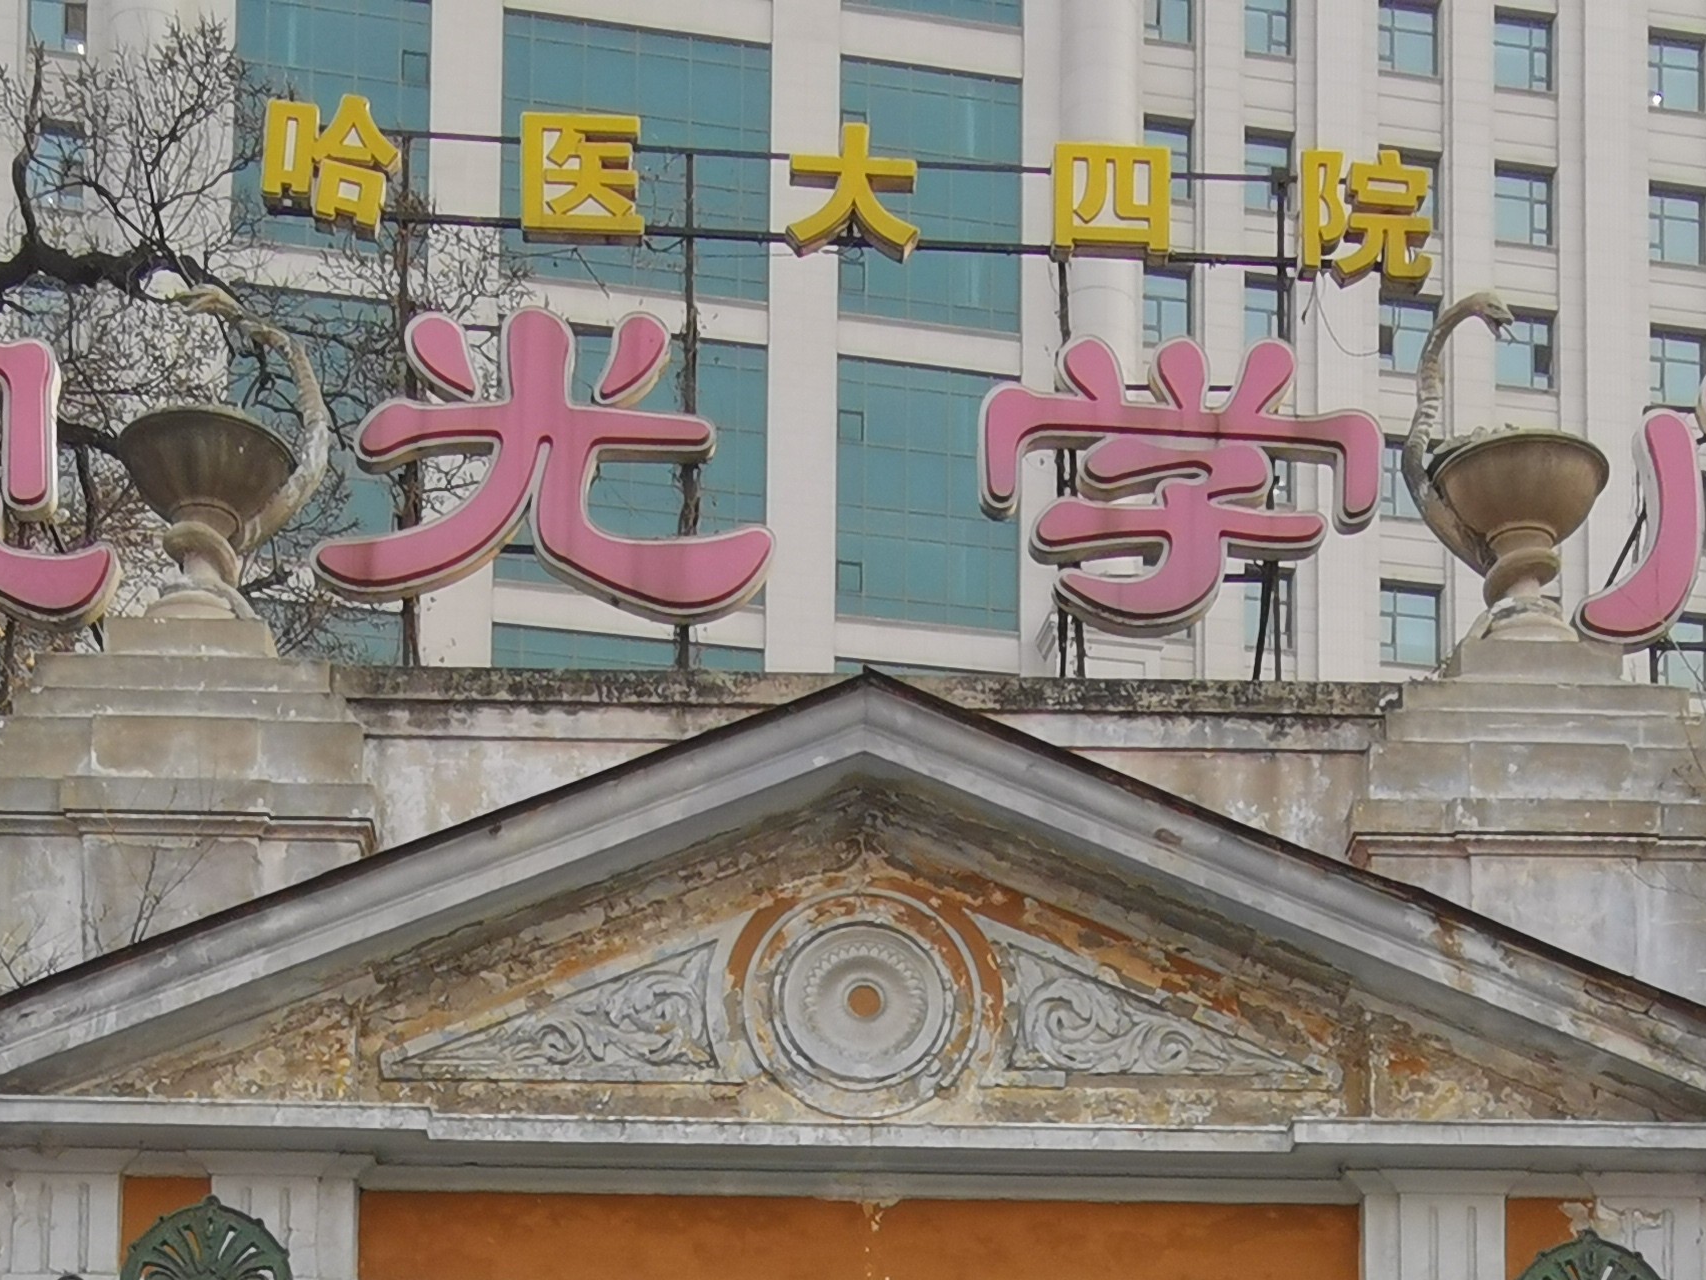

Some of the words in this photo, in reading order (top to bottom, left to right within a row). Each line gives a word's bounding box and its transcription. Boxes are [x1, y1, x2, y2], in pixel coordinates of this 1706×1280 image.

[261, 93, 1431, 297] 哈医大四院
